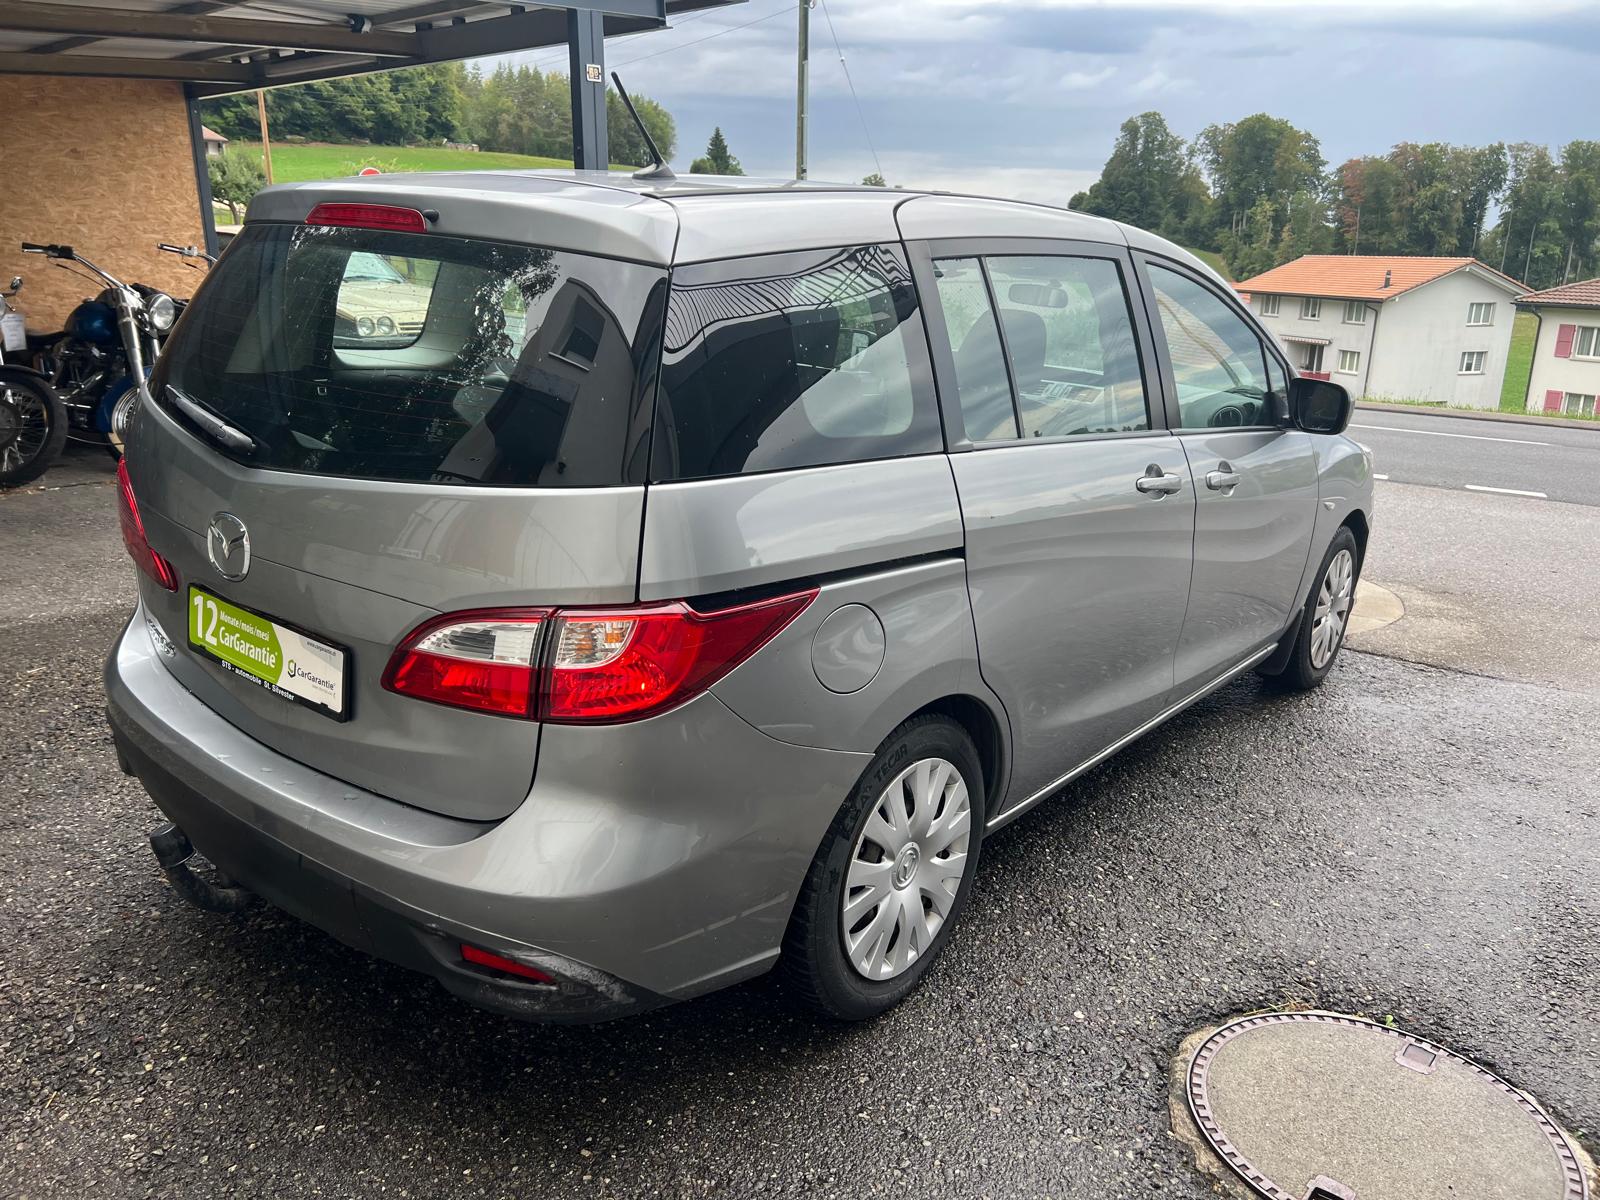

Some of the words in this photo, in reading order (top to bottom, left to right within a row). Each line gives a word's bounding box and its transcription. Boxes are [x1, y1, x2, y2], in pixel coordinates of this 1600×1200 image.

[193, 595, 218, 646] 12
[220, 611, 269, 641] Monate/mois/mesi
[221, 659, 232, 671] STS
[234, 667, 262, 685] automobile
[271, 684, 295, 701] Silvester
